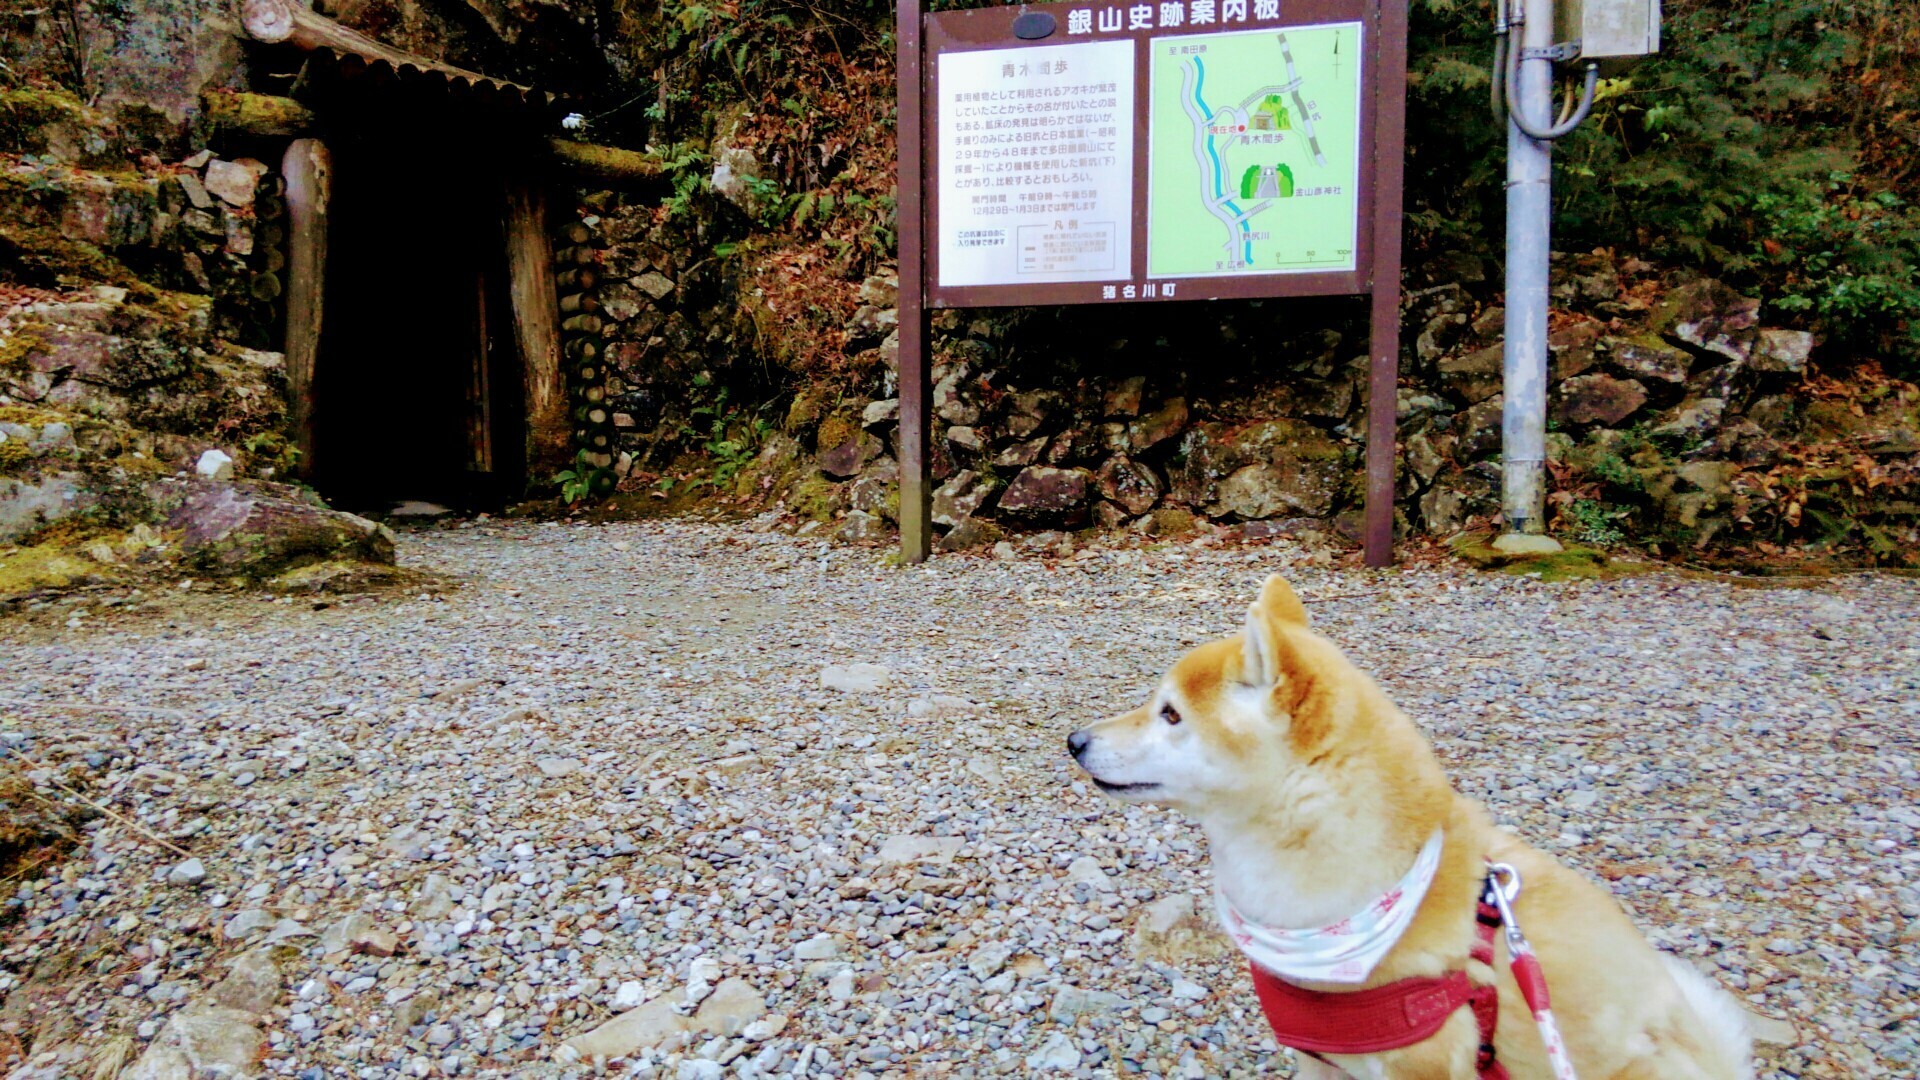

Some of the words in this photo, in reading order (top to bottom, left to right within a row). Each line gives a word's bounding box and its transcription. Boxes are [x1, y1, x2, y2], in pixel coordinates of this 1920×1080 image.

[1068, 0, 1280, 34] 銀山史跡案内板
[955, 98, 1116, 117] していたことからその名が付いたとの説
[1102, 282, 1177, 300] 猪名川町
